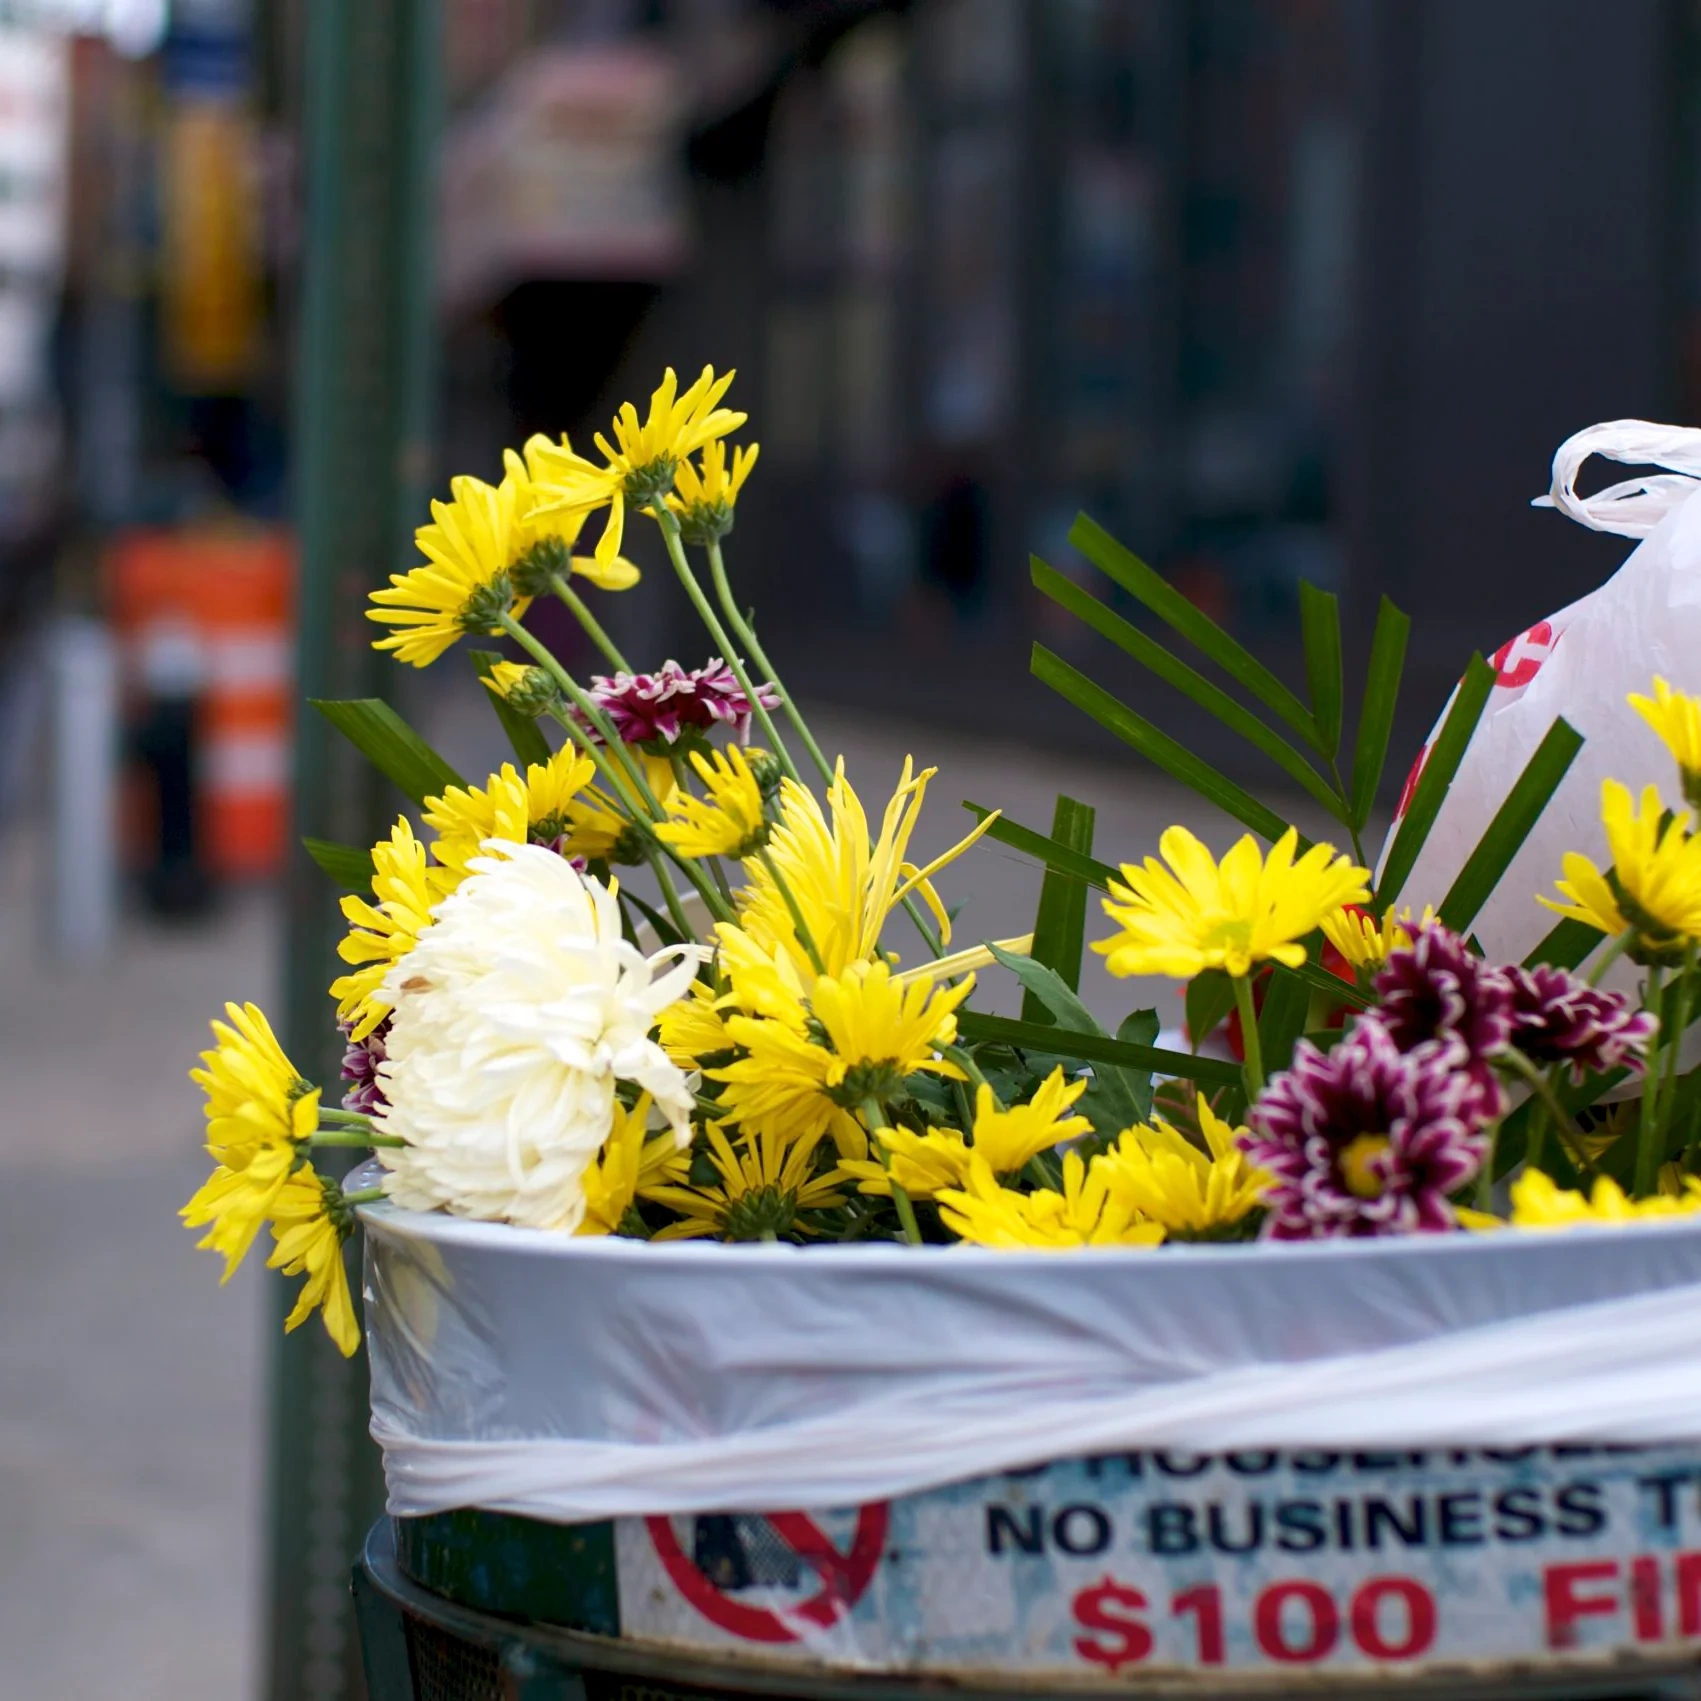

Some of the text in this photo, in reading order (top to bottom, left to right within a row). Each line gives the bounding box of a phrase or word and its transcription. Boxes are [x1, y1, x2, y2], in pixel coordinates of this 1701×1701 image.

[986, 1473, 1701, 1556] NO BUSINESS T
[1072, 1574, 1437, 1677] $100
